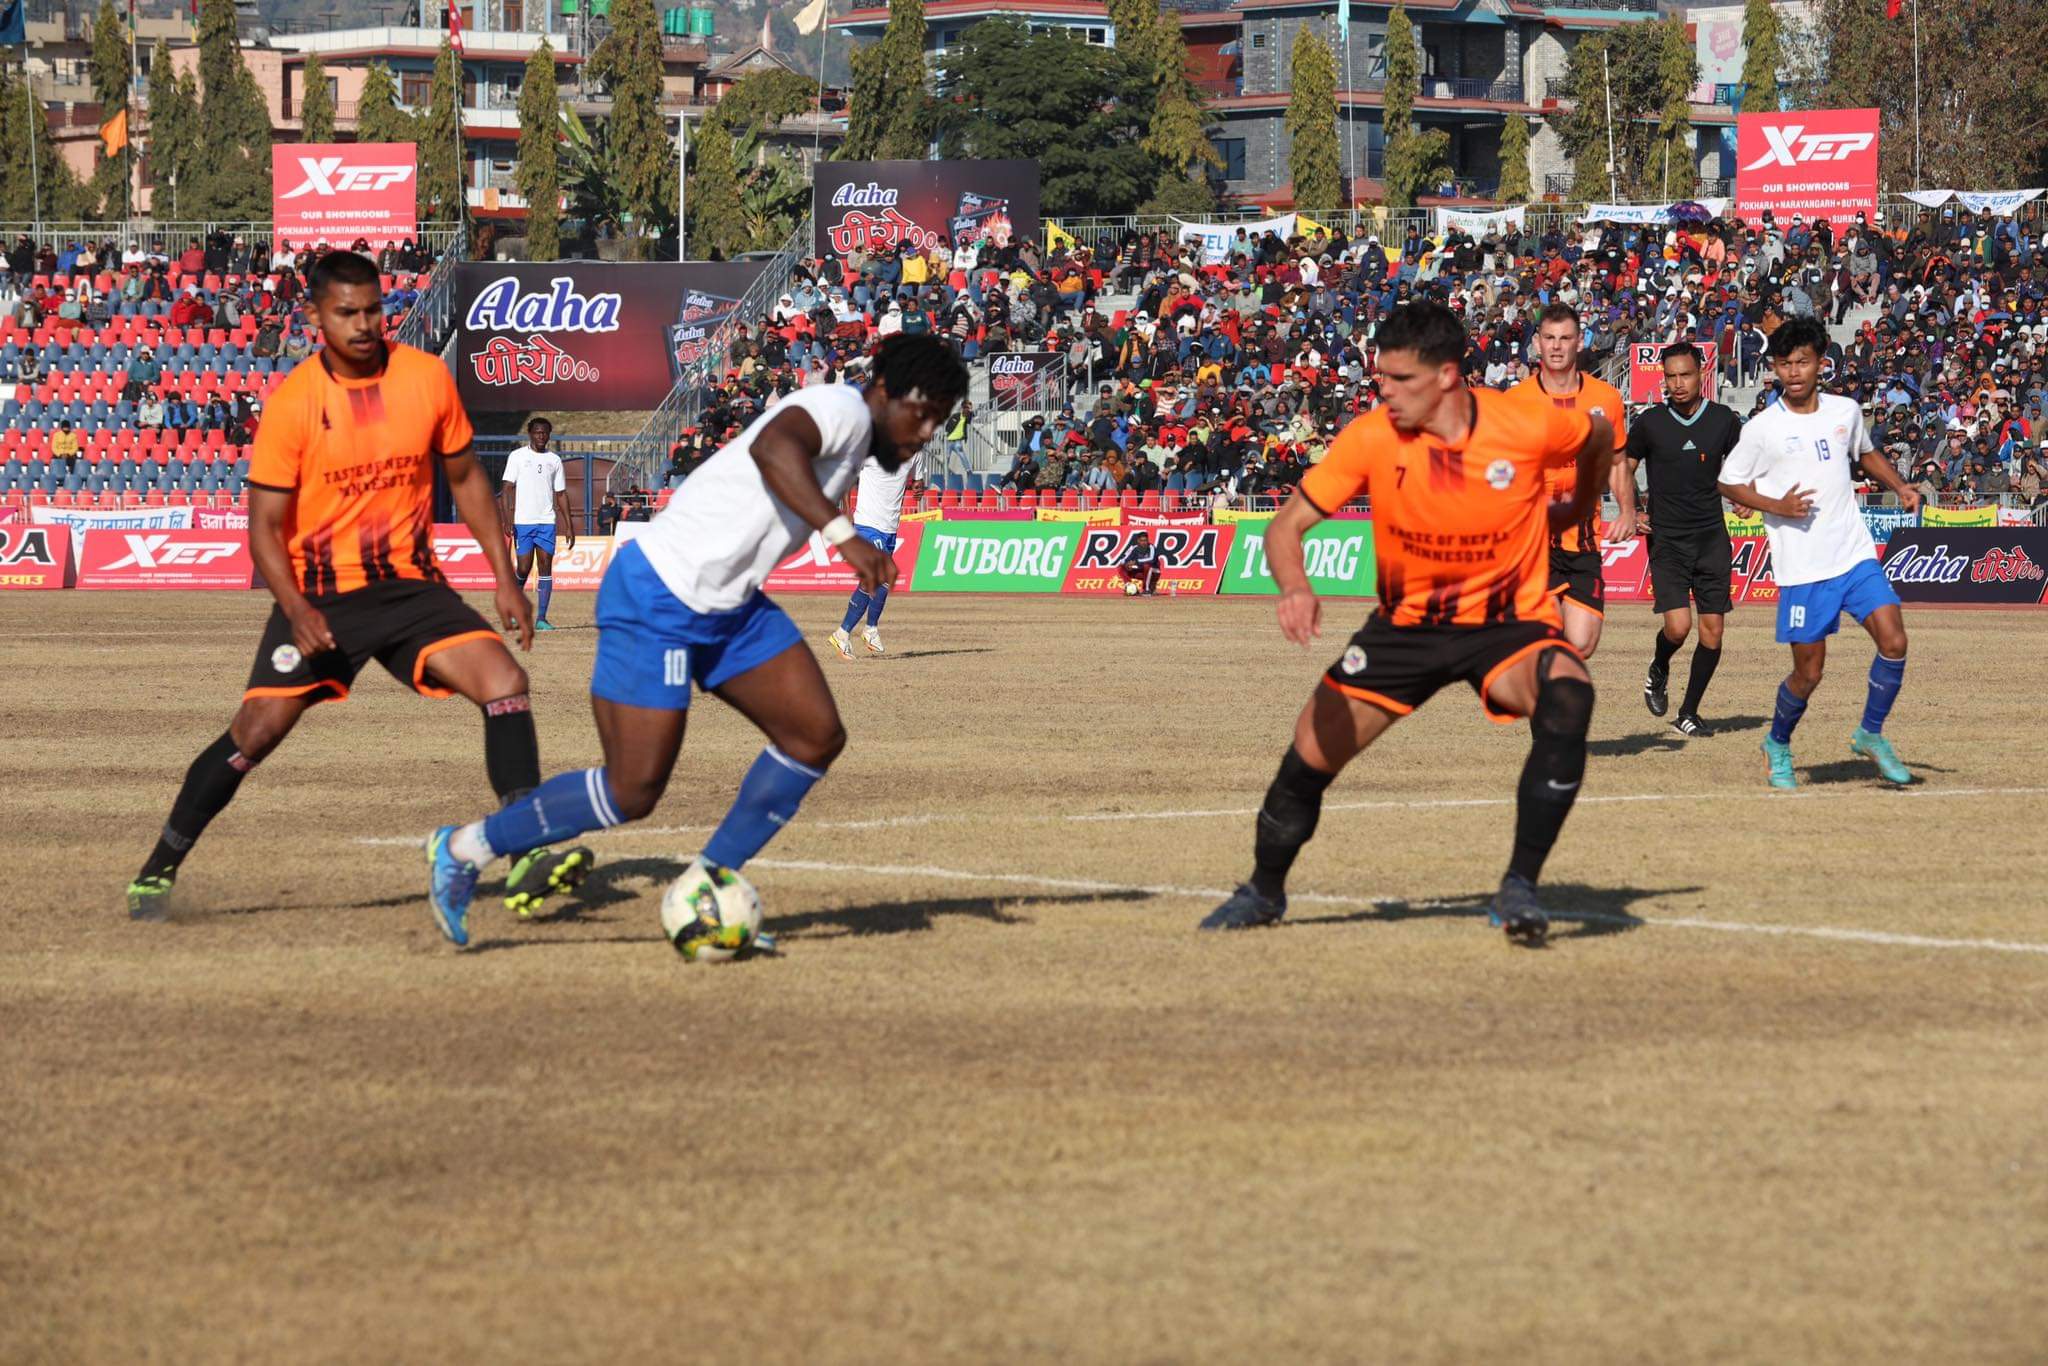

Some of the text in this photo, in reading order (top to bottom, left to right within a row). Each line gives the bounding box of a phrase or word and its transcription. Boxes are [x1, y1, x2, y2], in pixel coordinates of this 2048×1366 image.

[1741, 125, 1875, 171] XTEP
[279, 157, 414, 199] XTEP
[1762, 181, 1850, 193] OUR SHOWROOMS
[832, 182, 898, 206] Aaha
[1739, 198, 1873, 210] POKHARA NARAYANGARH BUTWAL
[301, 210, 390, 219] OUR SHOWROOMS
[466, 277, 621, 332] Aaha
[991, 356, 1034, 374] Aaha
[1815, 438, 1831, 462] 19
[537, 463, 543, 474] 3
[1395, 466, 1406, 490] 7
[98, 534, 241, 570] XTEP
[932, 534, 1068, 577] TUBORG
[1240, 534, 1363, 580] TORG
[1884, 545, 1969, 583] Aaha
[1790, 605, 1806, 628] 19
[664, 648, 687, 686] 10
